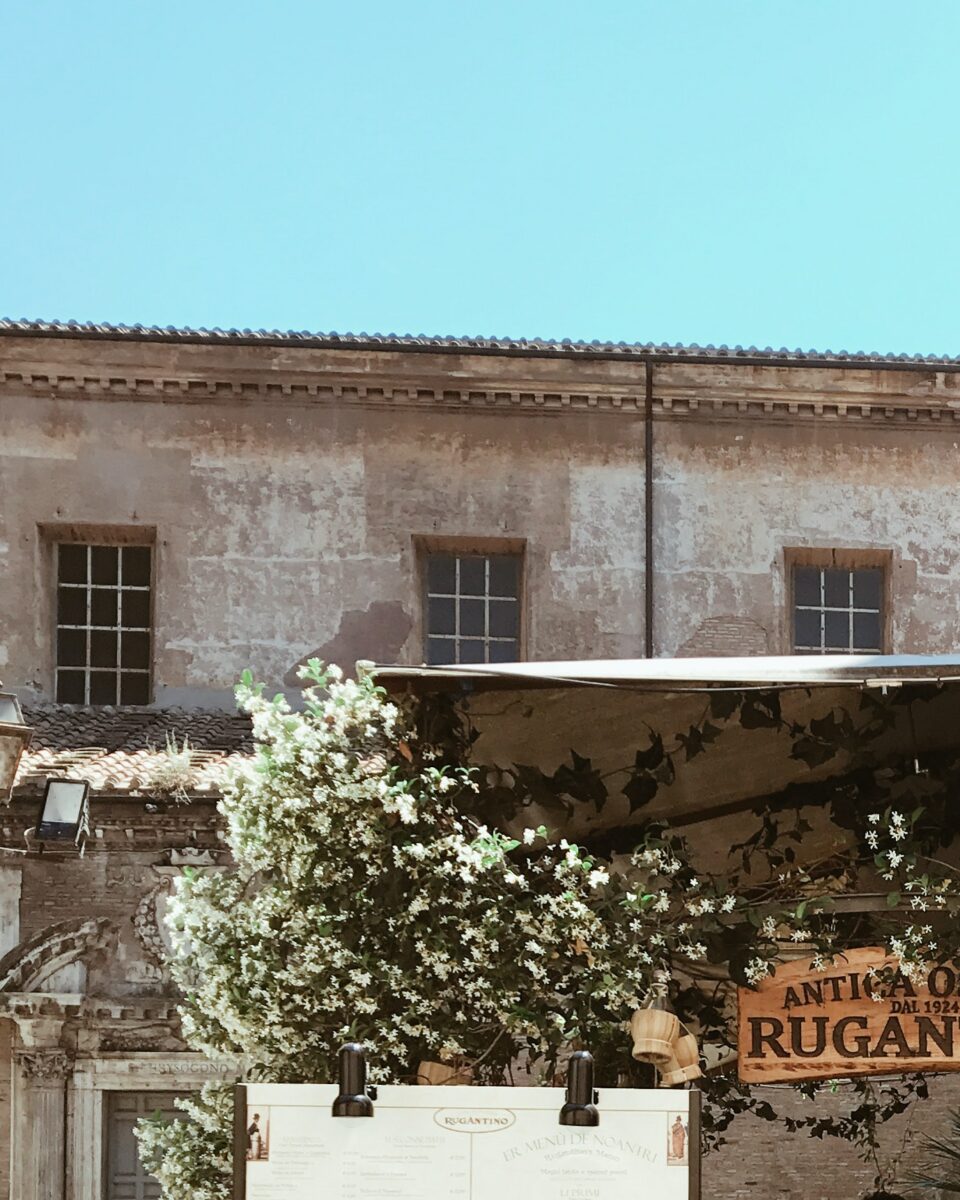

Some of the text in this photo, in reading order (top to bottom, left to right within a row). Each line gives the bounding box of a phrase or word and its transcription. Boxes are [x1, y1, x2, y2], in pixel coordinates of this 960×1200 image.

[782, 970, 917, 1009] ANTICA
[890, 999, 960, 1014] DAL 1924
[444, 1116, 509, 1126] RUGANTINO
[502, 1147, 522, 1163] ER
